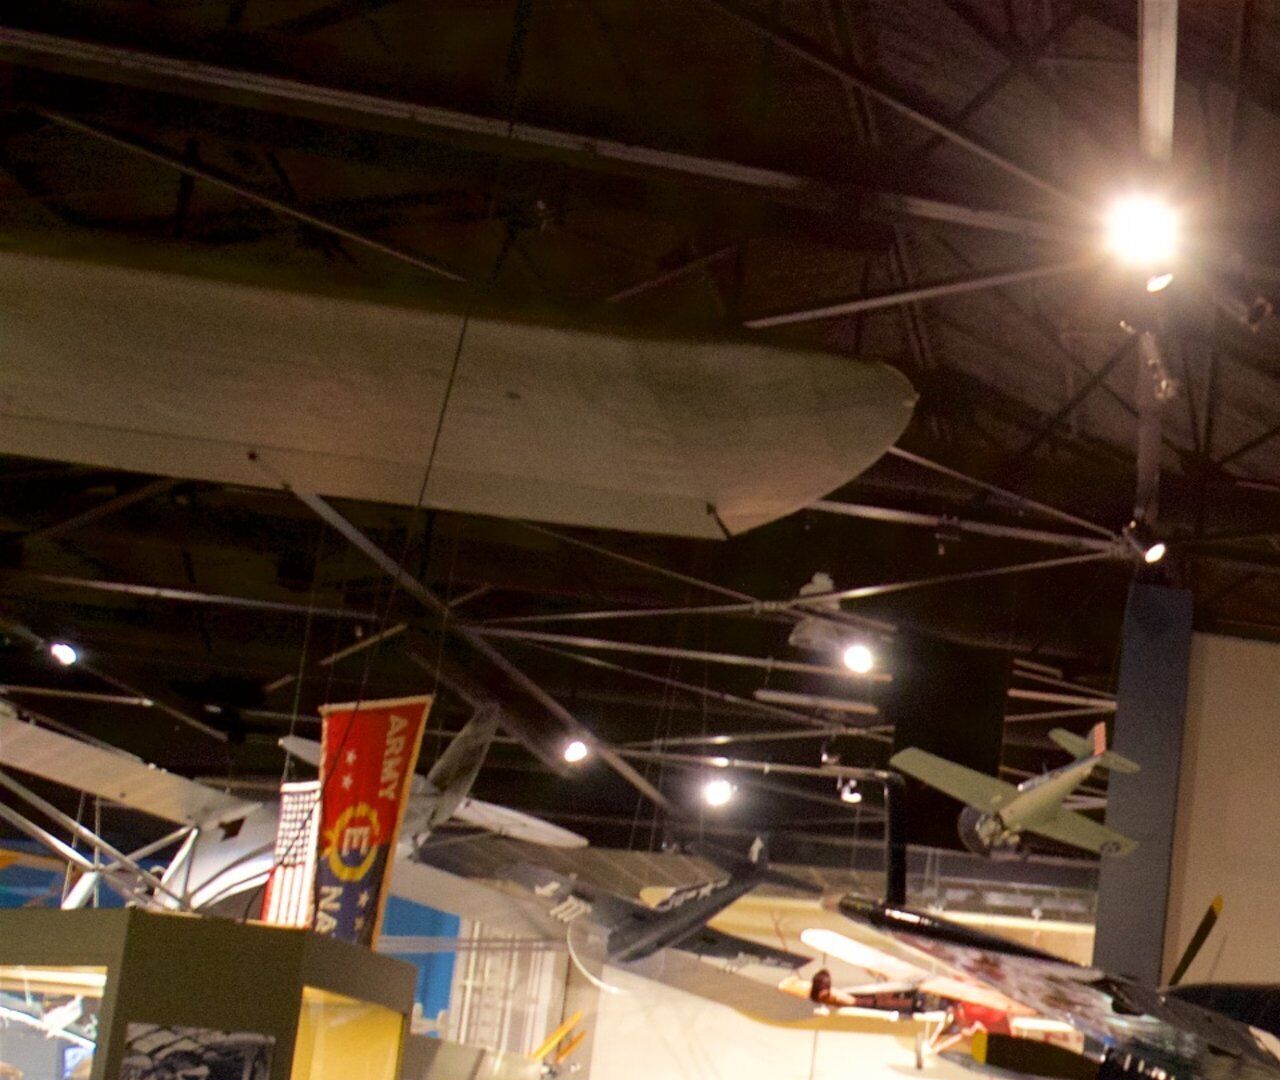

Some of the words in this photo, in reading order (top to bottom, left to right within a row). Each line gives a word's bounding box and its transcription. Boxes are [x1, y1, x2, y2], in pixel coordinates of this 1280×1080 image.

[378, 713, 408, 800] ARMY
[341, 825, 372, 857] E
[314, 885, 343, 936] NA
